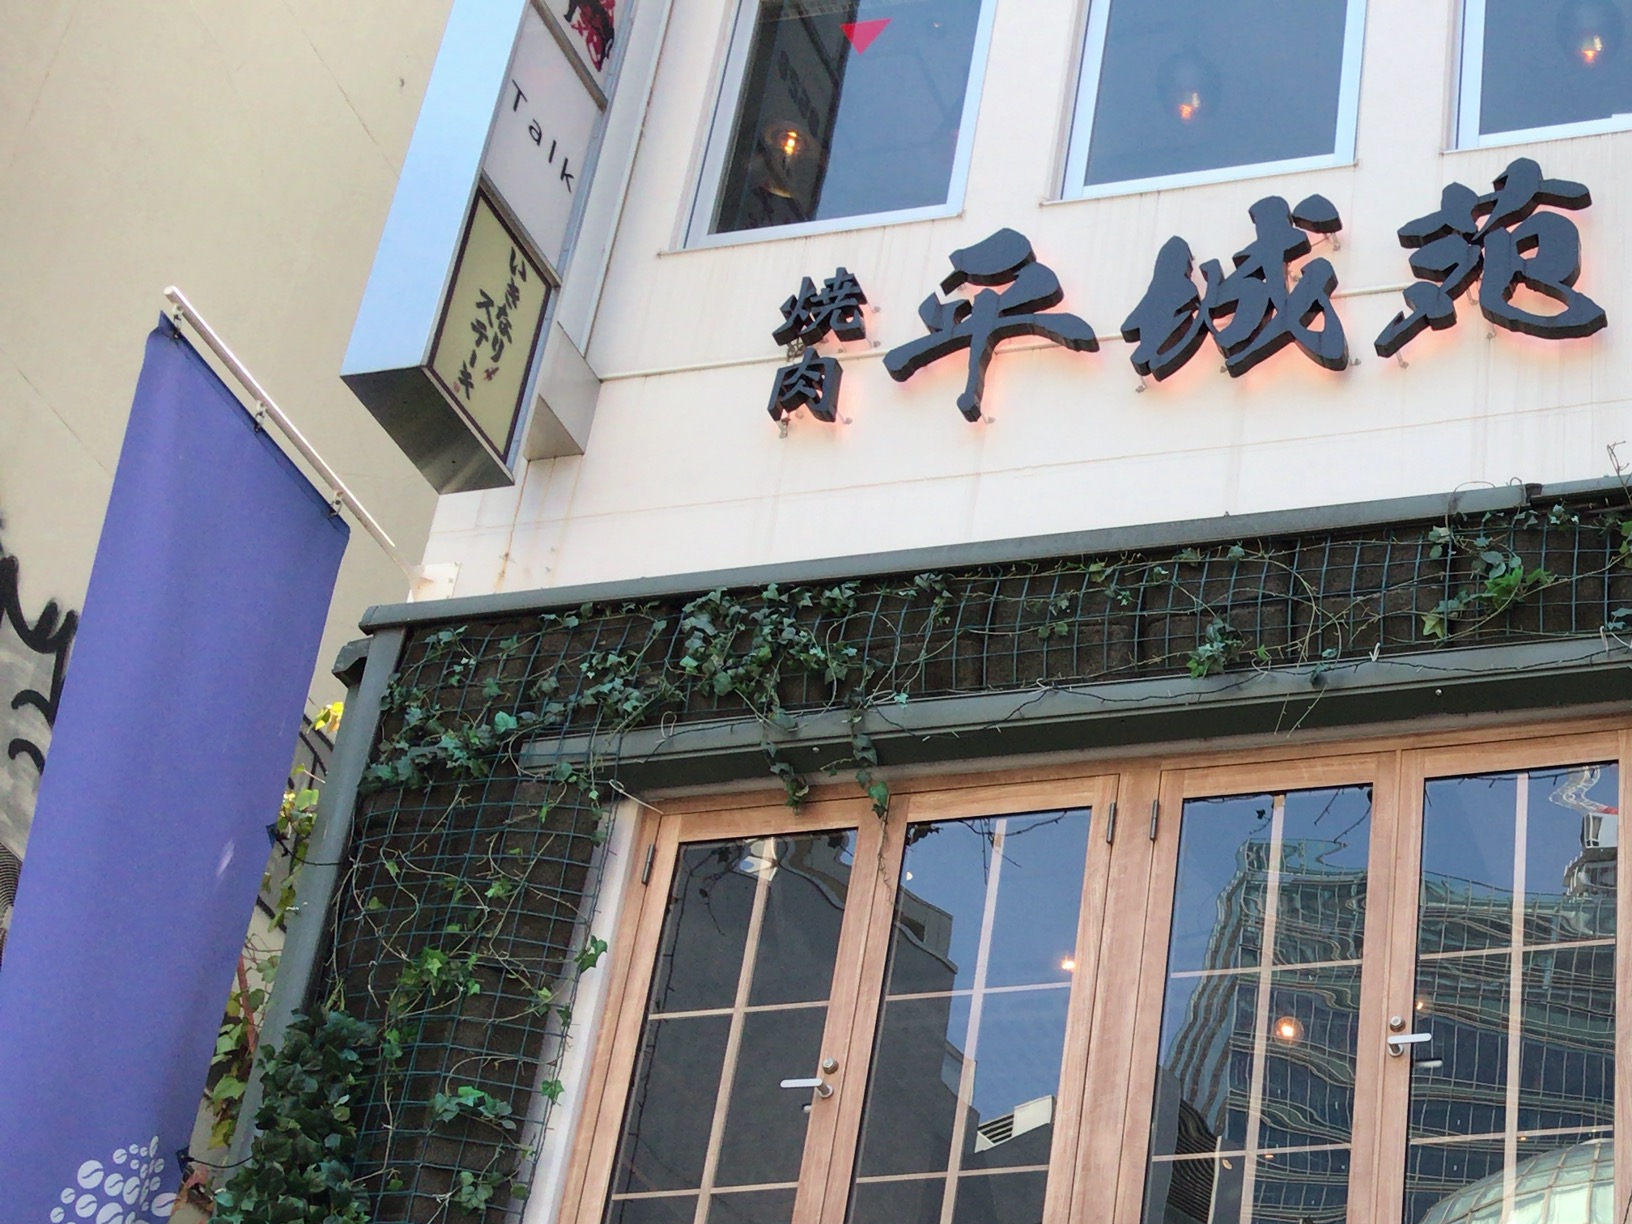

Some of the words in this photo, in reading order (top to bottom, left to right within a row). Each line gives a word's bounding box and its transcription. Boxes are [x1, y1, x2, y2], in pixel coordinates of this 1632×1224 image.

[511, 79, 575, 193] Talk
[457, 287, 495, 401] ステーキ
[490, 246, 527, 363] いきなり
[768, 266, 871, 424] 焼肉
[883, 157, 1608, 422] 平城苑
